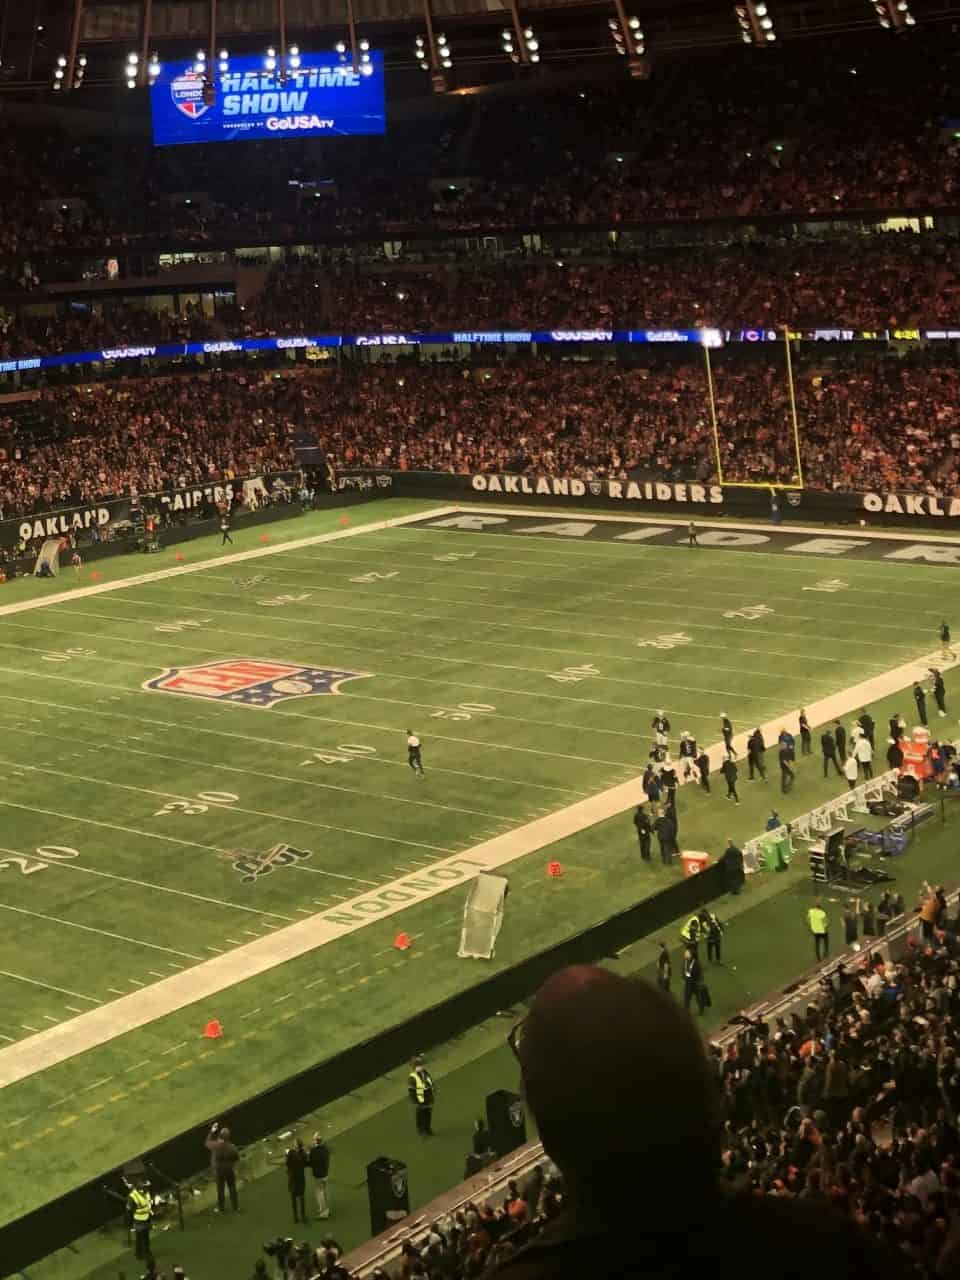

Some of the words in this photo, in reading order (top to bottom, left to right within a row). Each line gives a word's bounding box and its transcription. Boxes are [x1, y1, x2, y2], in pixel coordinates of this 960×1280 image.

[223, 92, 308, 115] SHOW
[453, 332, 502, 343] HALFTIME
[18, 358, 41, 369] SHOW
[472, 474, 586, 496] OAKLAND
[608, 480, 725, 505] RAIDERS
[323, 858, 486, 927] LONDON
